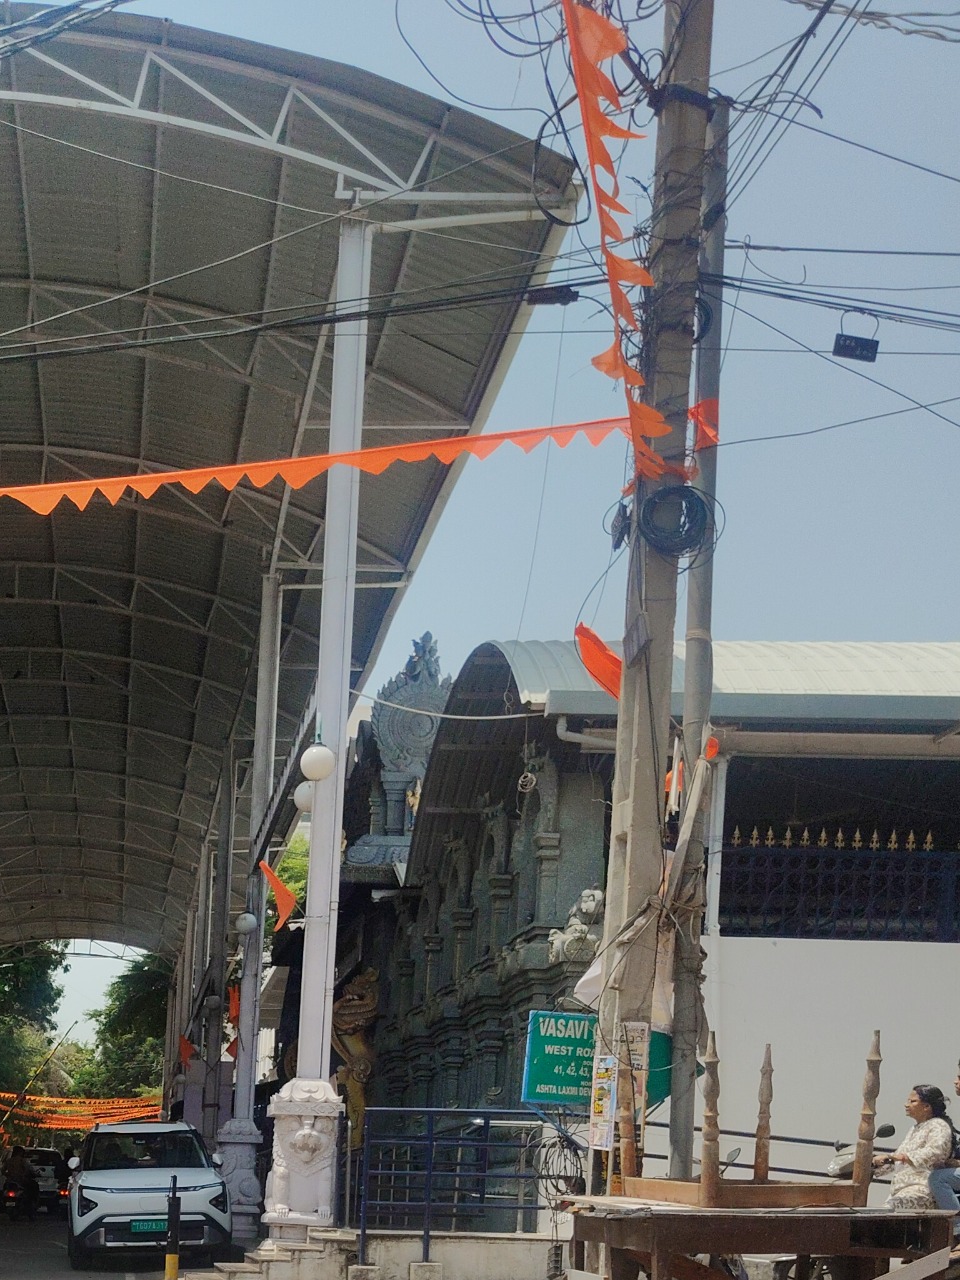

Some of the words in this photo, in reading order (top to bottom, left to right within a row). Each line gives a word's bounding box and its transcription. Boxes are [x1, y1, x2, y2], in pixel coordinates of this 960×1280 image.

[539, 1017, 589, 1039] VASAVI
[545, 1045, 573, 1056] WEST
[576, 1047, 596, 1058] ROA
[536, 1084, 557, 1094] ASHTA
[579, 1087, 592, 1096] DEV
